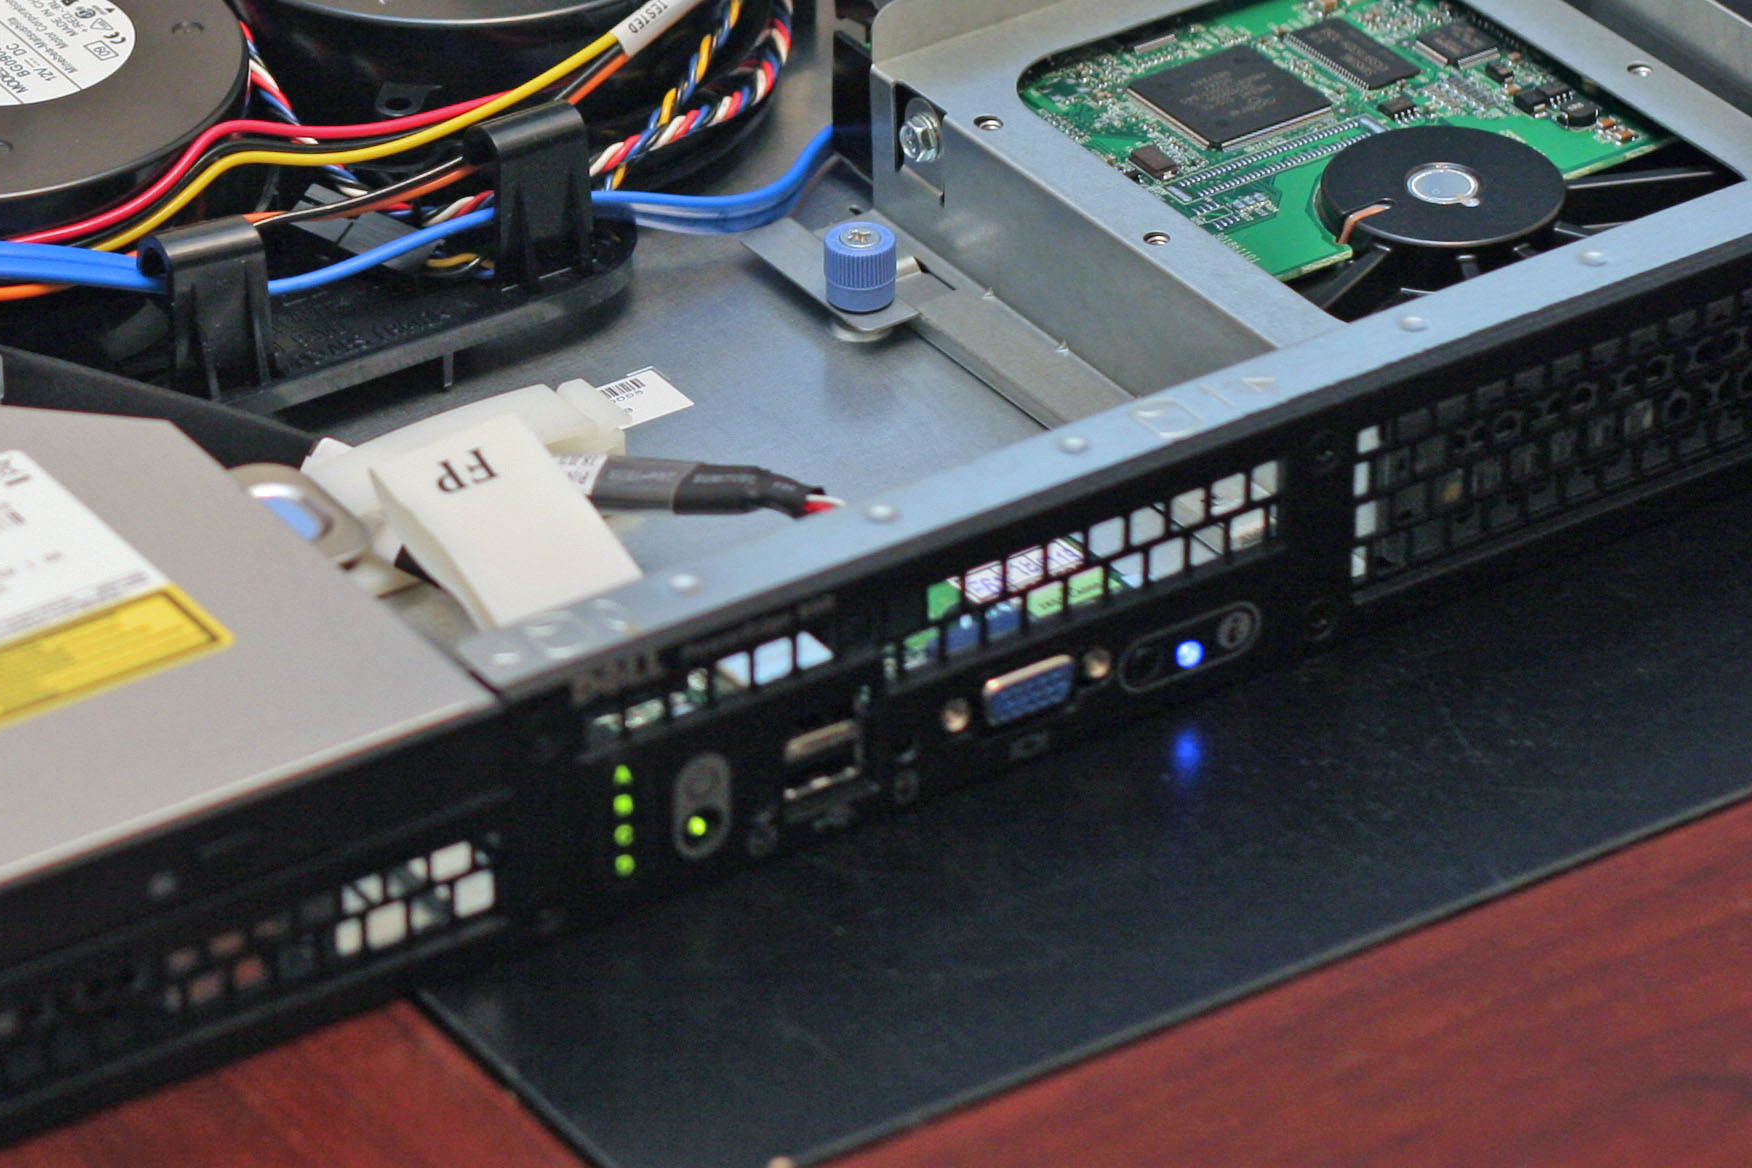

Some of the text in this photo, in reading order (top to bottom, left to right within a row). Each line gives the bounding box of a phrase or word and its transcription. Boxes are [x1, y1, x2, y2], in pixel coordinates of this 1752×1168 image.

[51, 17, 78, 36] MADE
[628, 0, 669, 34] TESTED
[4, 42, 27, 55] DC
[33, 67, 57, 81] 12V
[436, 446, 502, 494] FP
